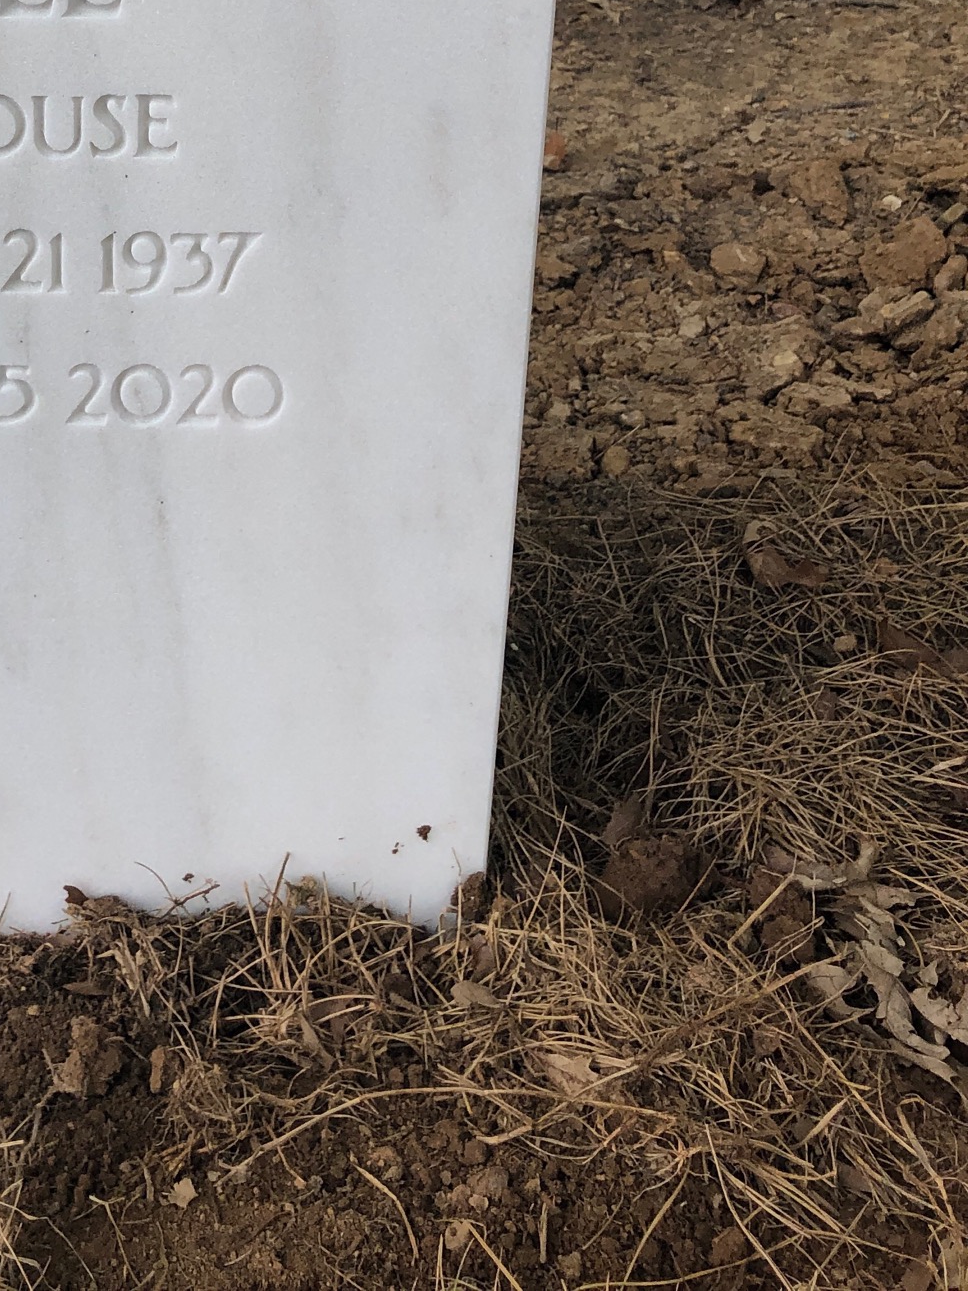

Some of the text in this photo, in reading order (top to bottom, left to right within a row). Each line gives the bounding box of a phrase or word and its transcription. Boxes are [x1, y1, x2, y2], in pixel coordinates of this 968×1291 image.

[0, 228, 66, 294] 21
[98, 230, 263, 295] 1937
[65, 362, 286, 427] 2020
